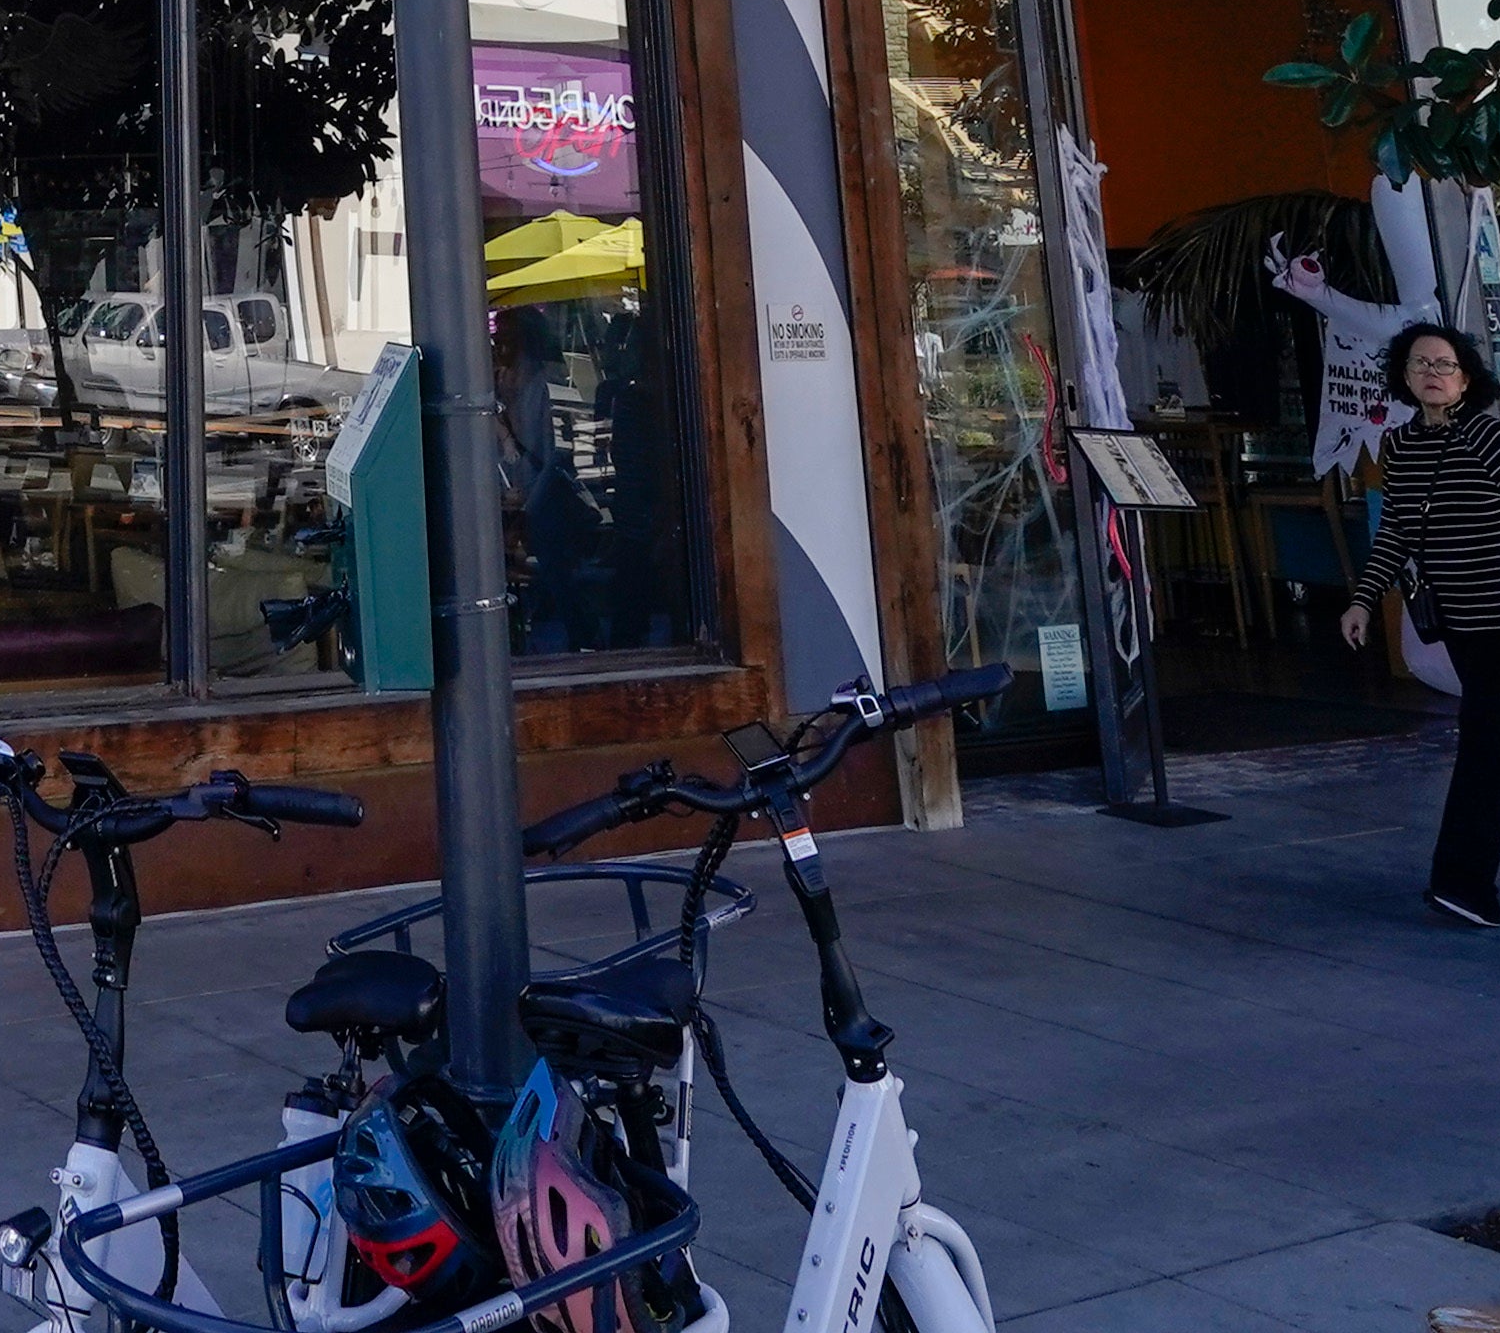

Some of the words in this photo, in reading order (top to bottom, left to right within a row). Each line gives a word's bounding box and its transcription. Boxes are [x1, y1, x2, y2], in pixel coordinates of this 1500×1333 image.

[772, 323, 785, 339] NO
[786, 323, 824, 339] SMOKING
[839, 1122, 857, 1172] XPEDITION
[470, 1301, 518, 1333] ORBITOR
